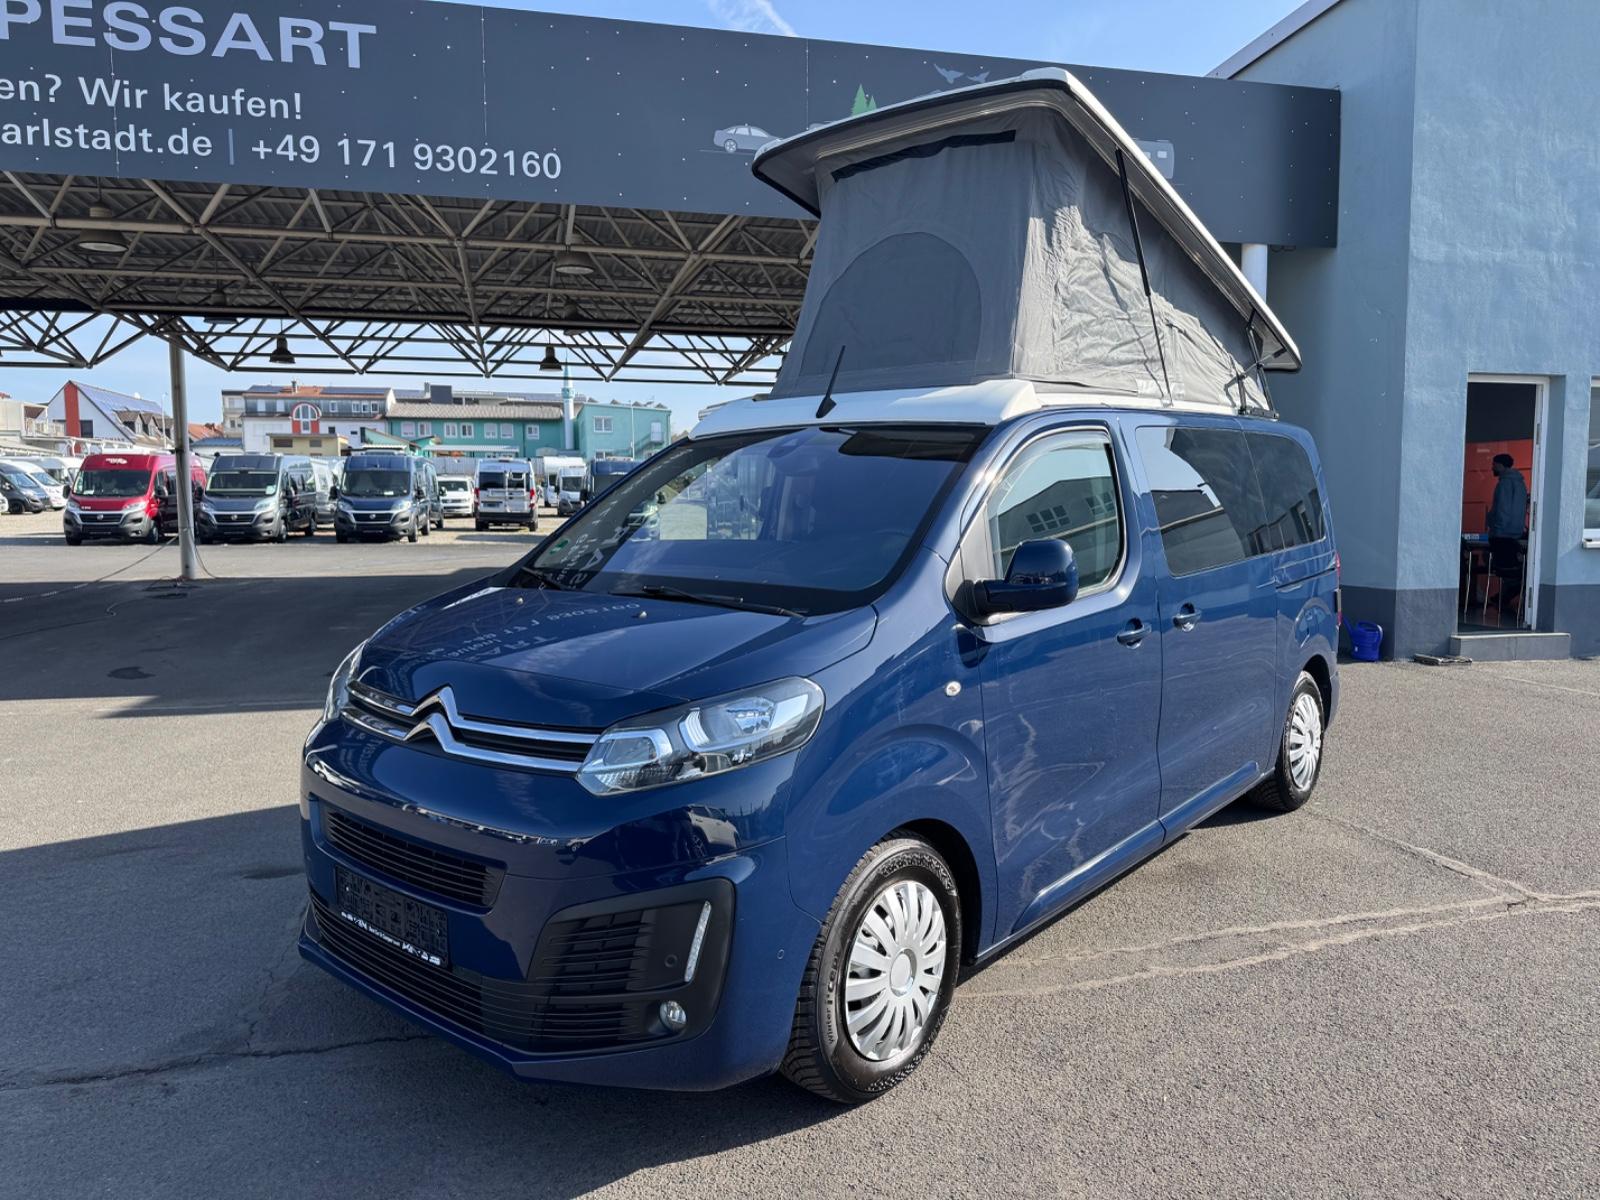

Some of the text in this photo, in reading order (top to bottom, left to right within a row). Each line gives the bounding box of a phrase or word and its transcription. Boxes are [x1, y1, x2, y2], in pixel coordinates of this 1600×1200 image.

[0, 0, 377, 69] PESSART
[79, 77, 148, 109] Wir
[163, 83, 302, 120] kaufen!
[1, 118, 562, 179] arlstadt.de +49 171 9302160
